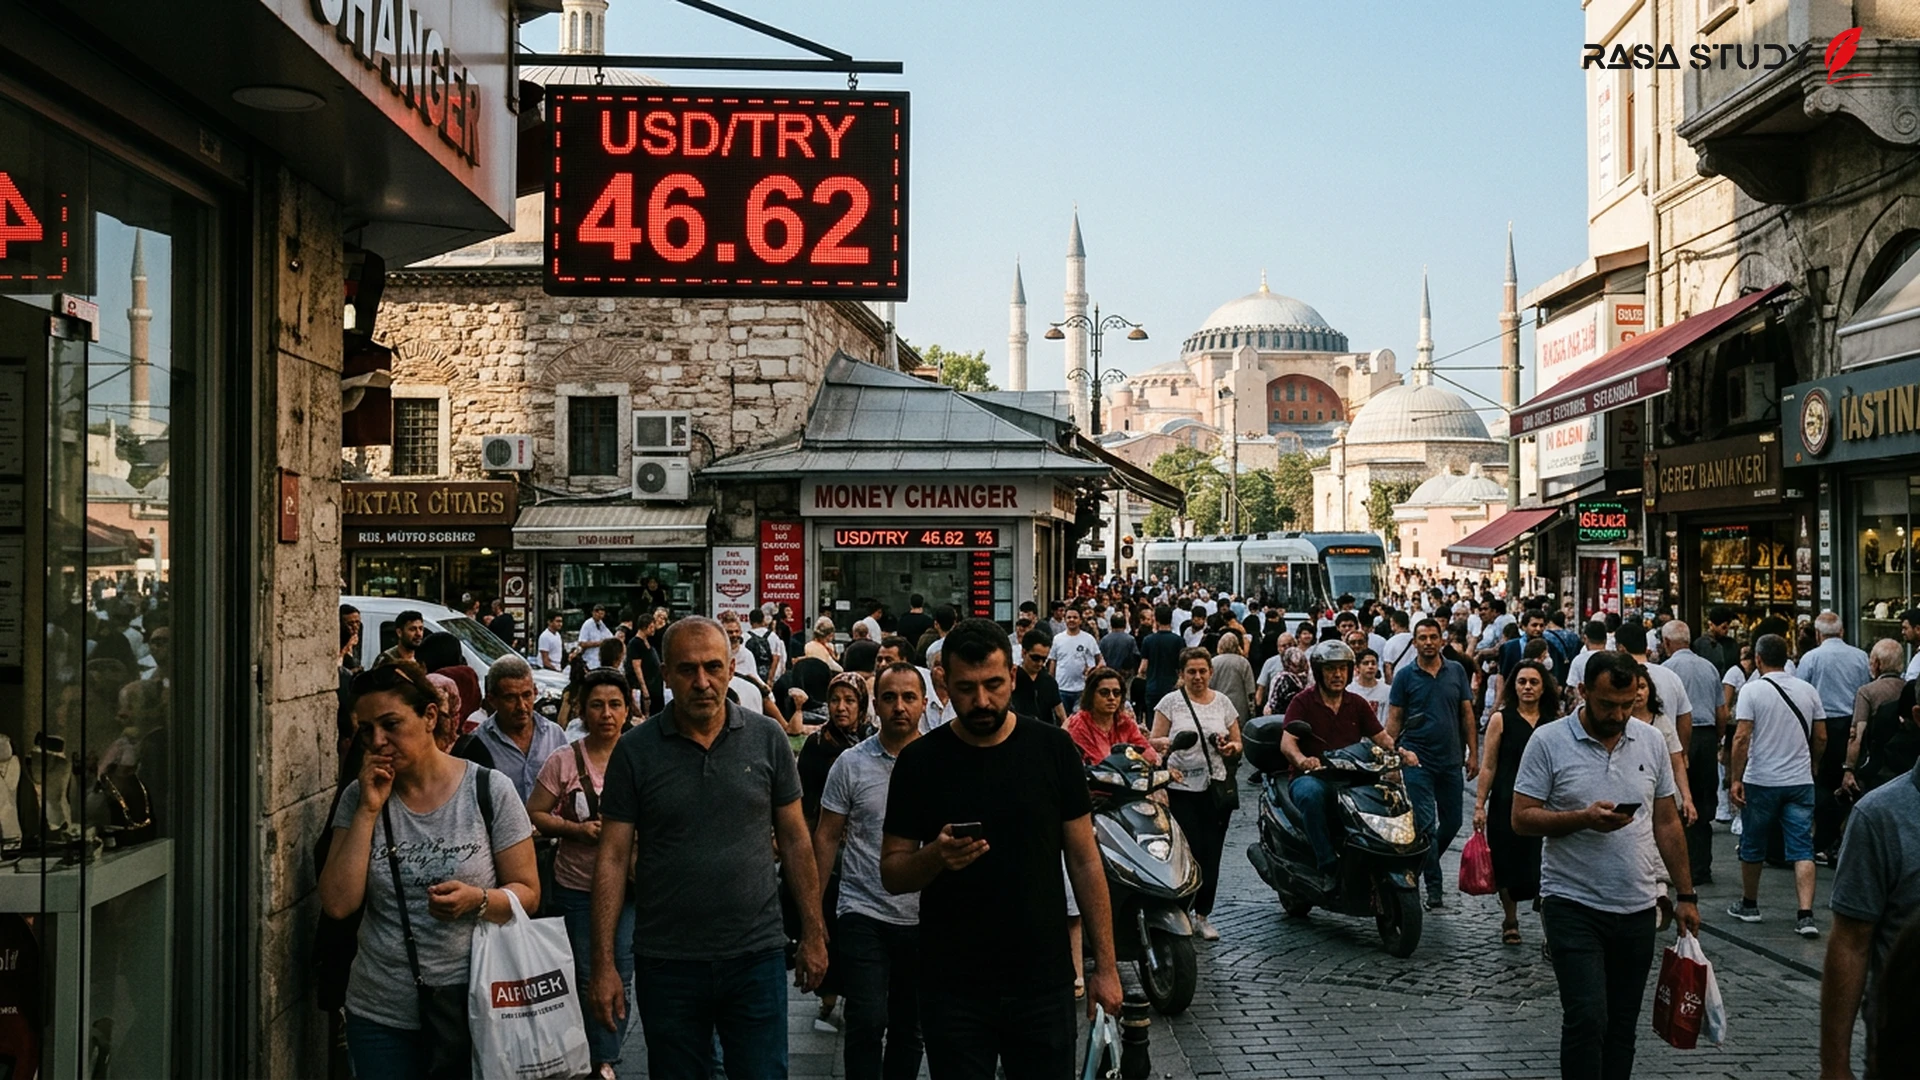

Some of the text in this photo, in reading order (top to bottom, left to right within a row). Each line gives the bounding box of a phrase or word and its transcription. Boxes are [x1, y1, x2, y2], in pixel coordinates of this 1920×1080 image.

[312, 0, 481, 168] HANGER
[602, 110, 855, 158] USD/TRY
[578, 173, 870, 264] 46.62
[815, 485, 1018, 508] MONEY CHANGER
[836, 531, 908, 546] USD/TRY
[920, 531, 964, 546] 46.62
